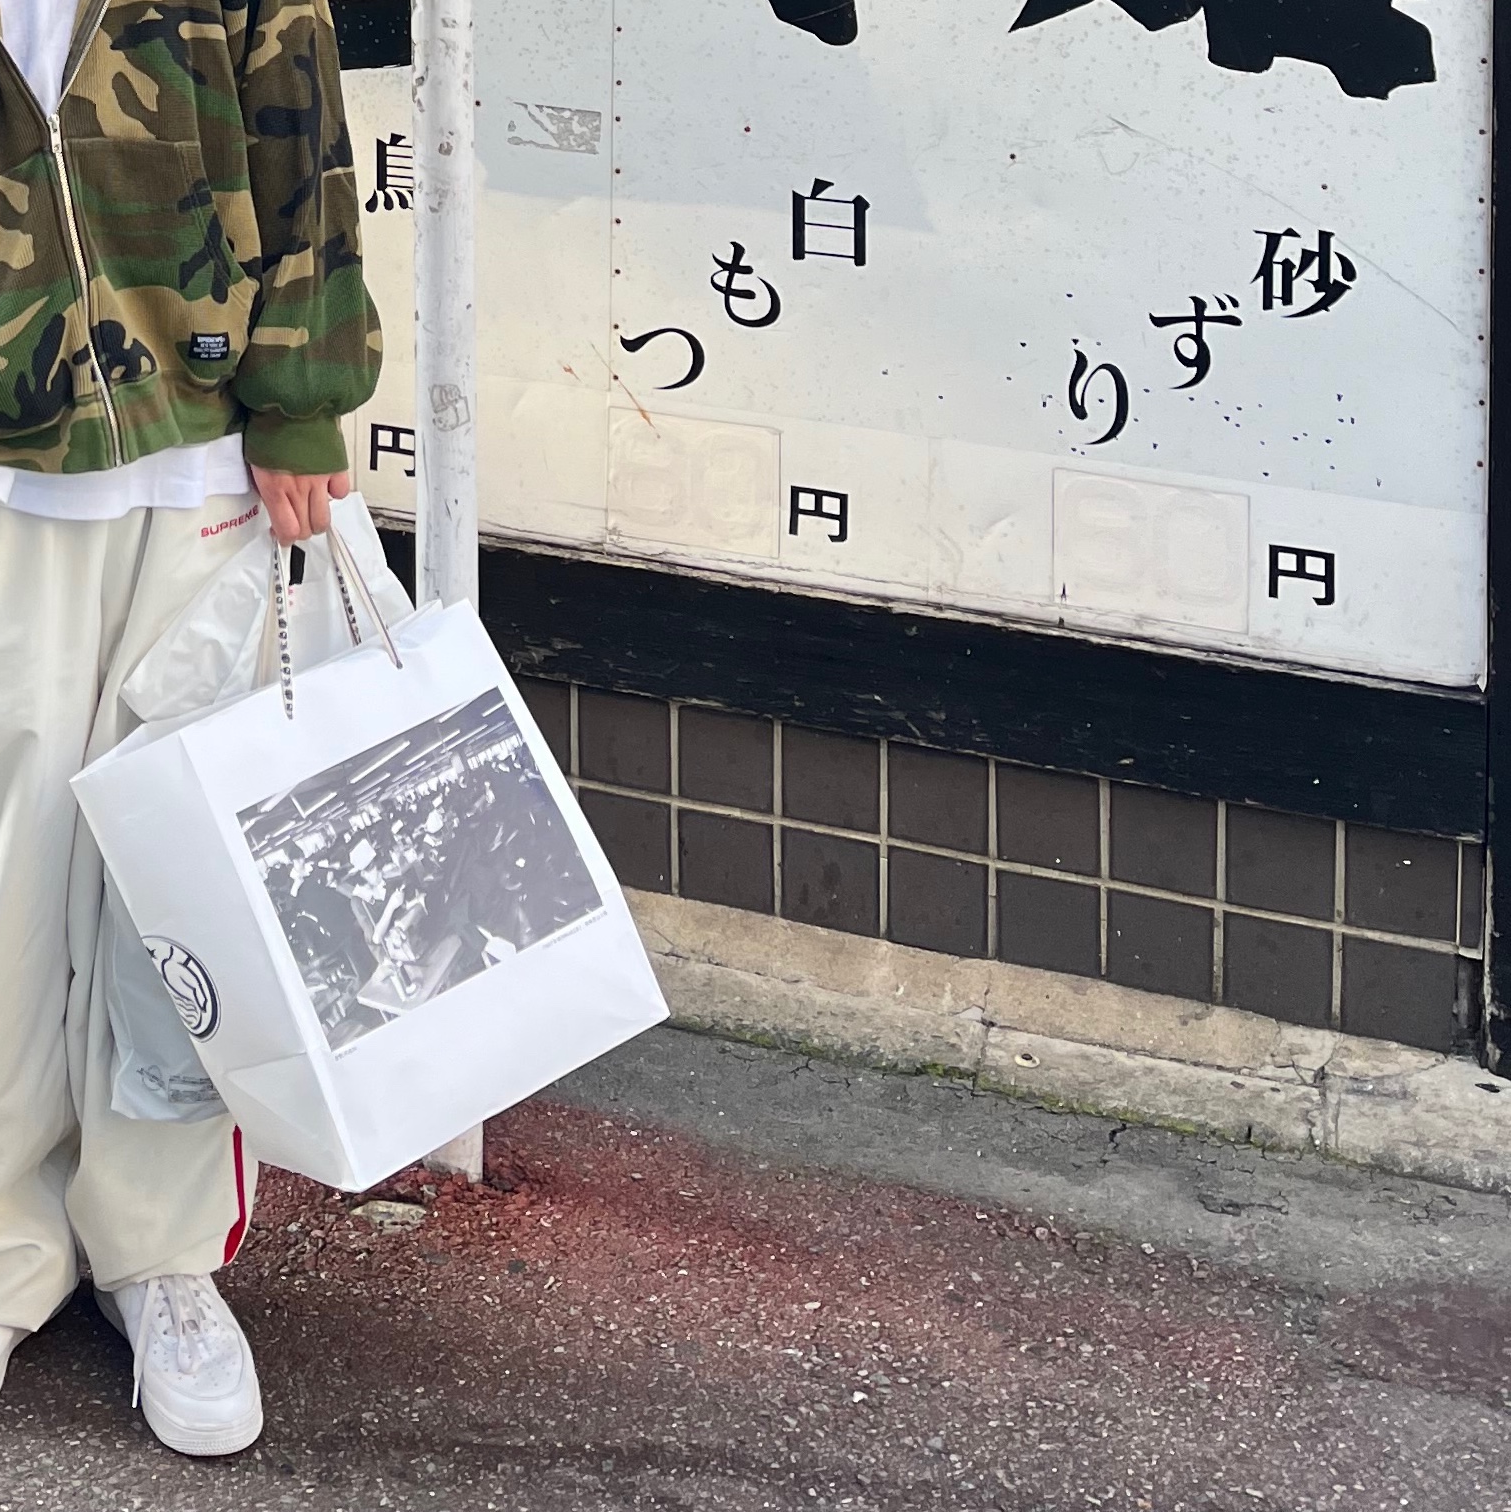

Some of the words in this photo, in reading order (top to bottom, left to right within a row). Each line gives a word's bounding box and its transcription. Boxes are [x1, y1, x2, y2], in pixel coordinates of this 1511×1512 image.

[619, 177, 870, 390] 白もつ
[1068, 227, 1357, 445] 砂ずり
[200, 504, 260, 538] SUPREME
[788, 485, 849, 543] 円
[1268, 543, 1336, 606] 円
